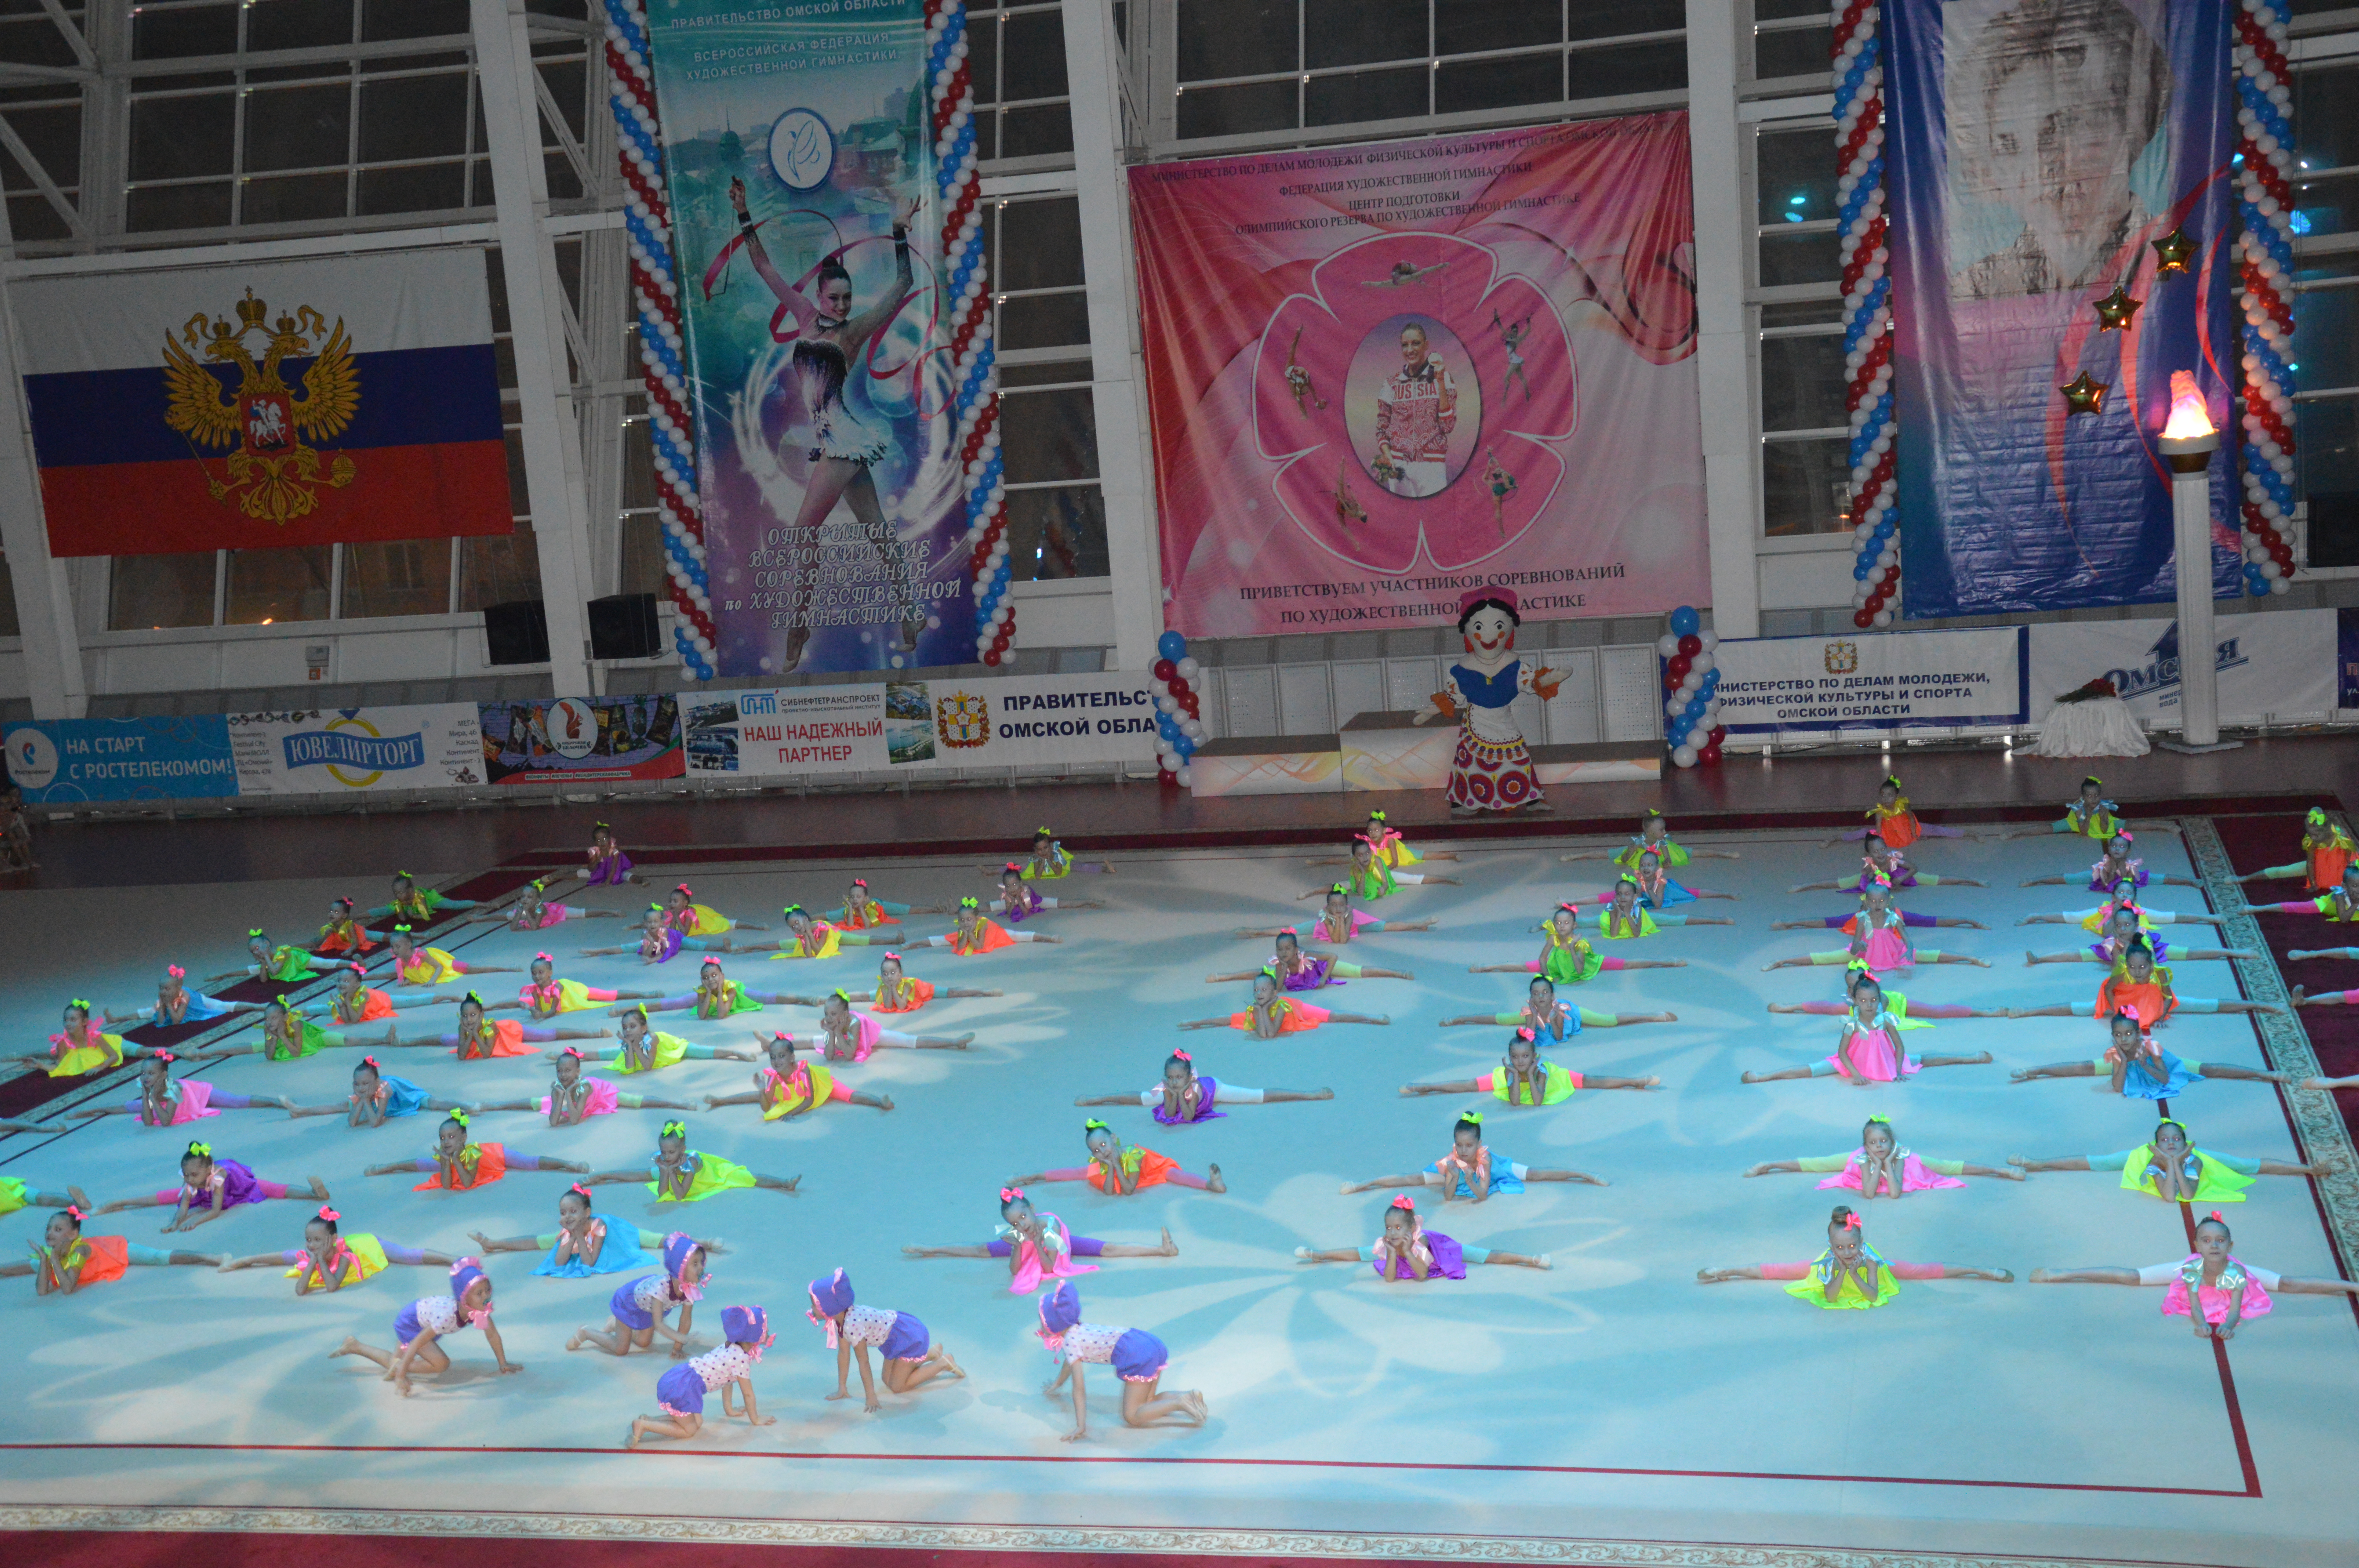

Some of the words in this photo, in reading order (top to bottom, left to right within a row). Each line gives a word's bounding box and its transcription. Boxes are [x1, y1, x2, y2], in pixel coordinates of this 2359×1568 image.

[671, 8, 781, 29] ПРАВИТЕЛЬСТВО
[786, 0, 839, 17] ОМСКОЙ
[694, 41, 804, 62] ВСЕРОССИЙСКАЯ
[811, 32, 888, 49] ФЕДЕРАЦИЯ
[687, 58, 806, 80] ХУДОЖЕСТВЕННОЙ
[812, 49, 900, 67] ГИМНАСТИКИ.
[1152, 165, 1237, 182] МИНИСТЕРСТВО
[1239, 164, 1255, 175] ПО
[1258, 161, 1294, 174] ДЕЛАМ
[1298, 155, 1363, 170] МОЛОДЕЖИ
[1367, 145, 1443, 163] ФИЗИЧЕСКОЙ
[1446, 140, 1505, 157] КУЛЬТУРЫ
[1508, 138, 1516, 148] И
[1279, 181, 1343, 196] ФЕДЕРАЦИЯ
[1347, 169, 1450, 191] ХУДОЖЕСТВЕННОЙ
[1454, 162, 1532, 179] ГИМНАСТИКИ
[1236, 217, 1328, 234] ОЛИМПИЙСКОГО
[1331, 214, 1375, 226] РЕЗЕРВА
[1377, 212, 1393, 222] ПО
[1396, 200, 1501, 223] ХУДОЖЕСТВЕННОЙ
[1504, 192, 1581, 210] ГИМНАСТИКЕ
[1349, 198, 1383, 211] ЦЕНТР
[1386, 191, 1460, 208] ПОДГОТОВКИ
[768, 520, 898, 545] ОТКРЫТЫЕ
[748, 539, 931, 568] ВСЕРОССИЙСКИЕ
[755, 562, 928, 588] СОРЕВНОВАНИЯ
[1240, 581, 1366, 599] ПРИВЕТСТВУЕМ
[1370, 575, 1483, 596] УЧАСТНИКОВ
[1487, 562, 1625, 587] СОРЕВНОВАНИЙ
[749, 577, 961, 609] ХУДОЖЕСТВЕННОЙ
[771, 604, 925, 628] ГИМНАСТИКЕ
[1281, 610, 1305, 623] ПО
[1517, 593, 1586, 610] АСТИКЕ
[2103, 637, 2240, 694] ОМСЯ
[1714, 680, 1814, 692] ИНИСТЕРСТВО
[1819, 679, 1839, 688] ПО
[1844, 676, 1894, 689] ДЕЛАМ
[1899, 673, 1990, 685] МОЛОДЕЖИ,
[1819, 691, 1894, 702] КУЛЬТУРЫ
[1899, 690, 1909, 699] И
[1914, 688, 1972, 699] СПОРТА
[781, 694, 880, 706] СИБНЕФТЕТРАНСПРОЕКТ
[1003, 690, 1151, 711] ПРАВИТЕЛЬС
[1777, 705, 1837, 718] ОМСКОЙ
[1843, 704, 1910, 716] ОБЛАСТИ
[2159, 699, 2178, 708] вода
[744, 725, 781, 742] НАШ
[787, 717, 883, 742] НАДЕЖНЫЙ
[999, 717, 1090, 739] ОМСКОЙ
[1097, 718, 1155, 735] ОБЛА
[66, 739, 90, 754] НА
[95, 737, 145, 754] СТАРТ
[289, 736, 420, 765] ЮВЕЛИРТОРГ
[778, 745, 852, 763] ПАРТНЕР
[70, 764, 79, 779] С
[85, 758, 232, 779] РОСТЕЛЕКОМОМ!
